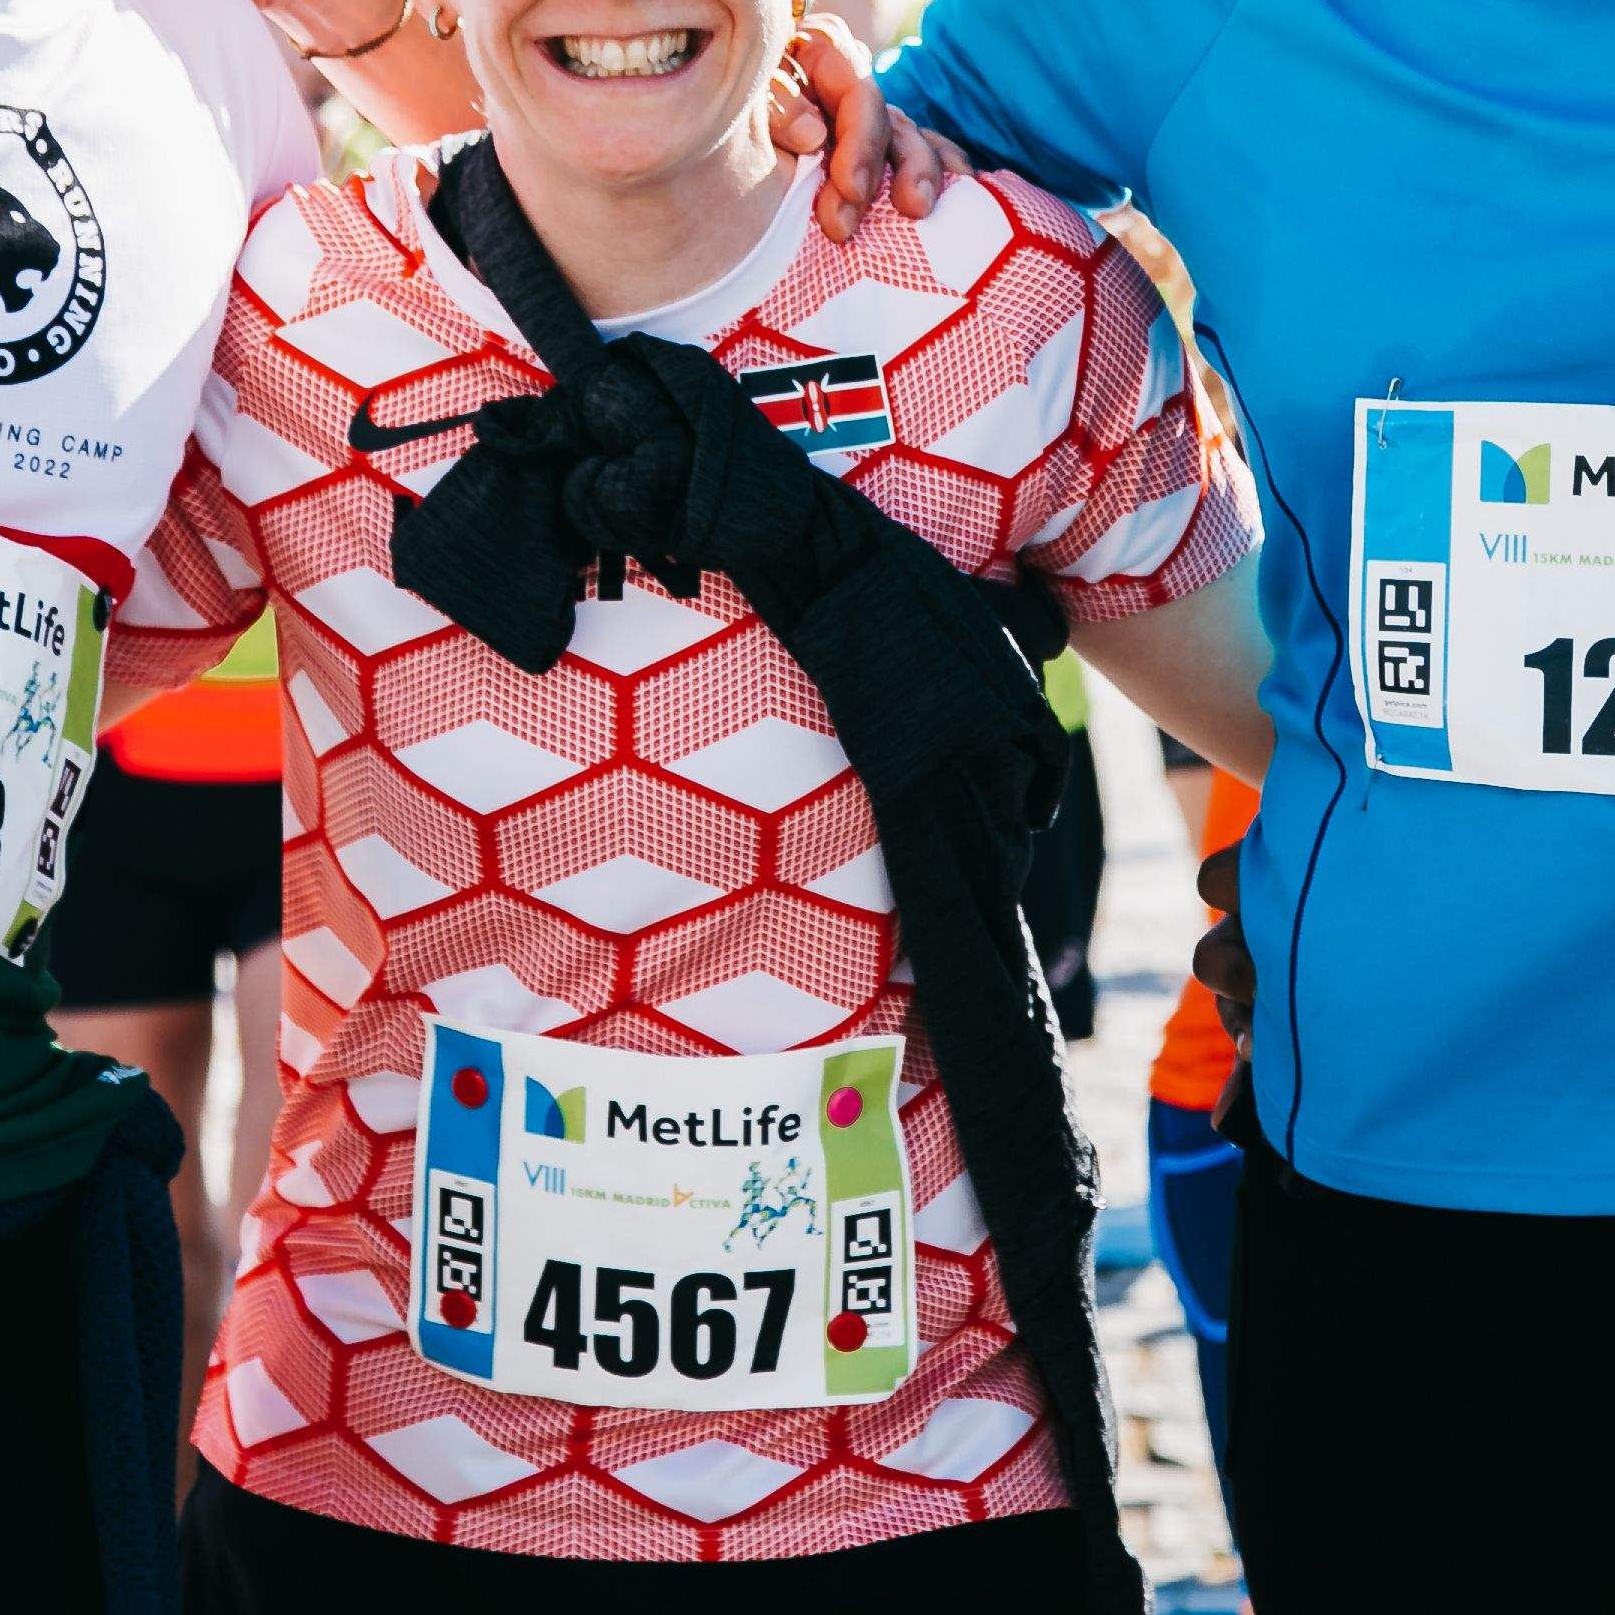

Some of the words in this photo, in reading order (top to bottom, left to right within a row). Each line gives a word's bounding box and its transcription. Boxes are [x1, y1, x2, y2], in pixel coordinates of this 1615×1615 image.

[46, 157, 105, 355] RUNNING
[13, 452, 73, 480] 2022
[61, 435, 125, 464] CAMP
[1479, 533, 1527, 563] VIII
[1533, 552, 1573, 565] 15KM
[605, 1100, 802, 1148] MetLife
[522, 1161, 566, 1196] VIII
[571, 1187, 607, 1201] 15KM
[611, 1192, 671, 1208] MADRID
[522, 1258, 796, 1380] 4567
